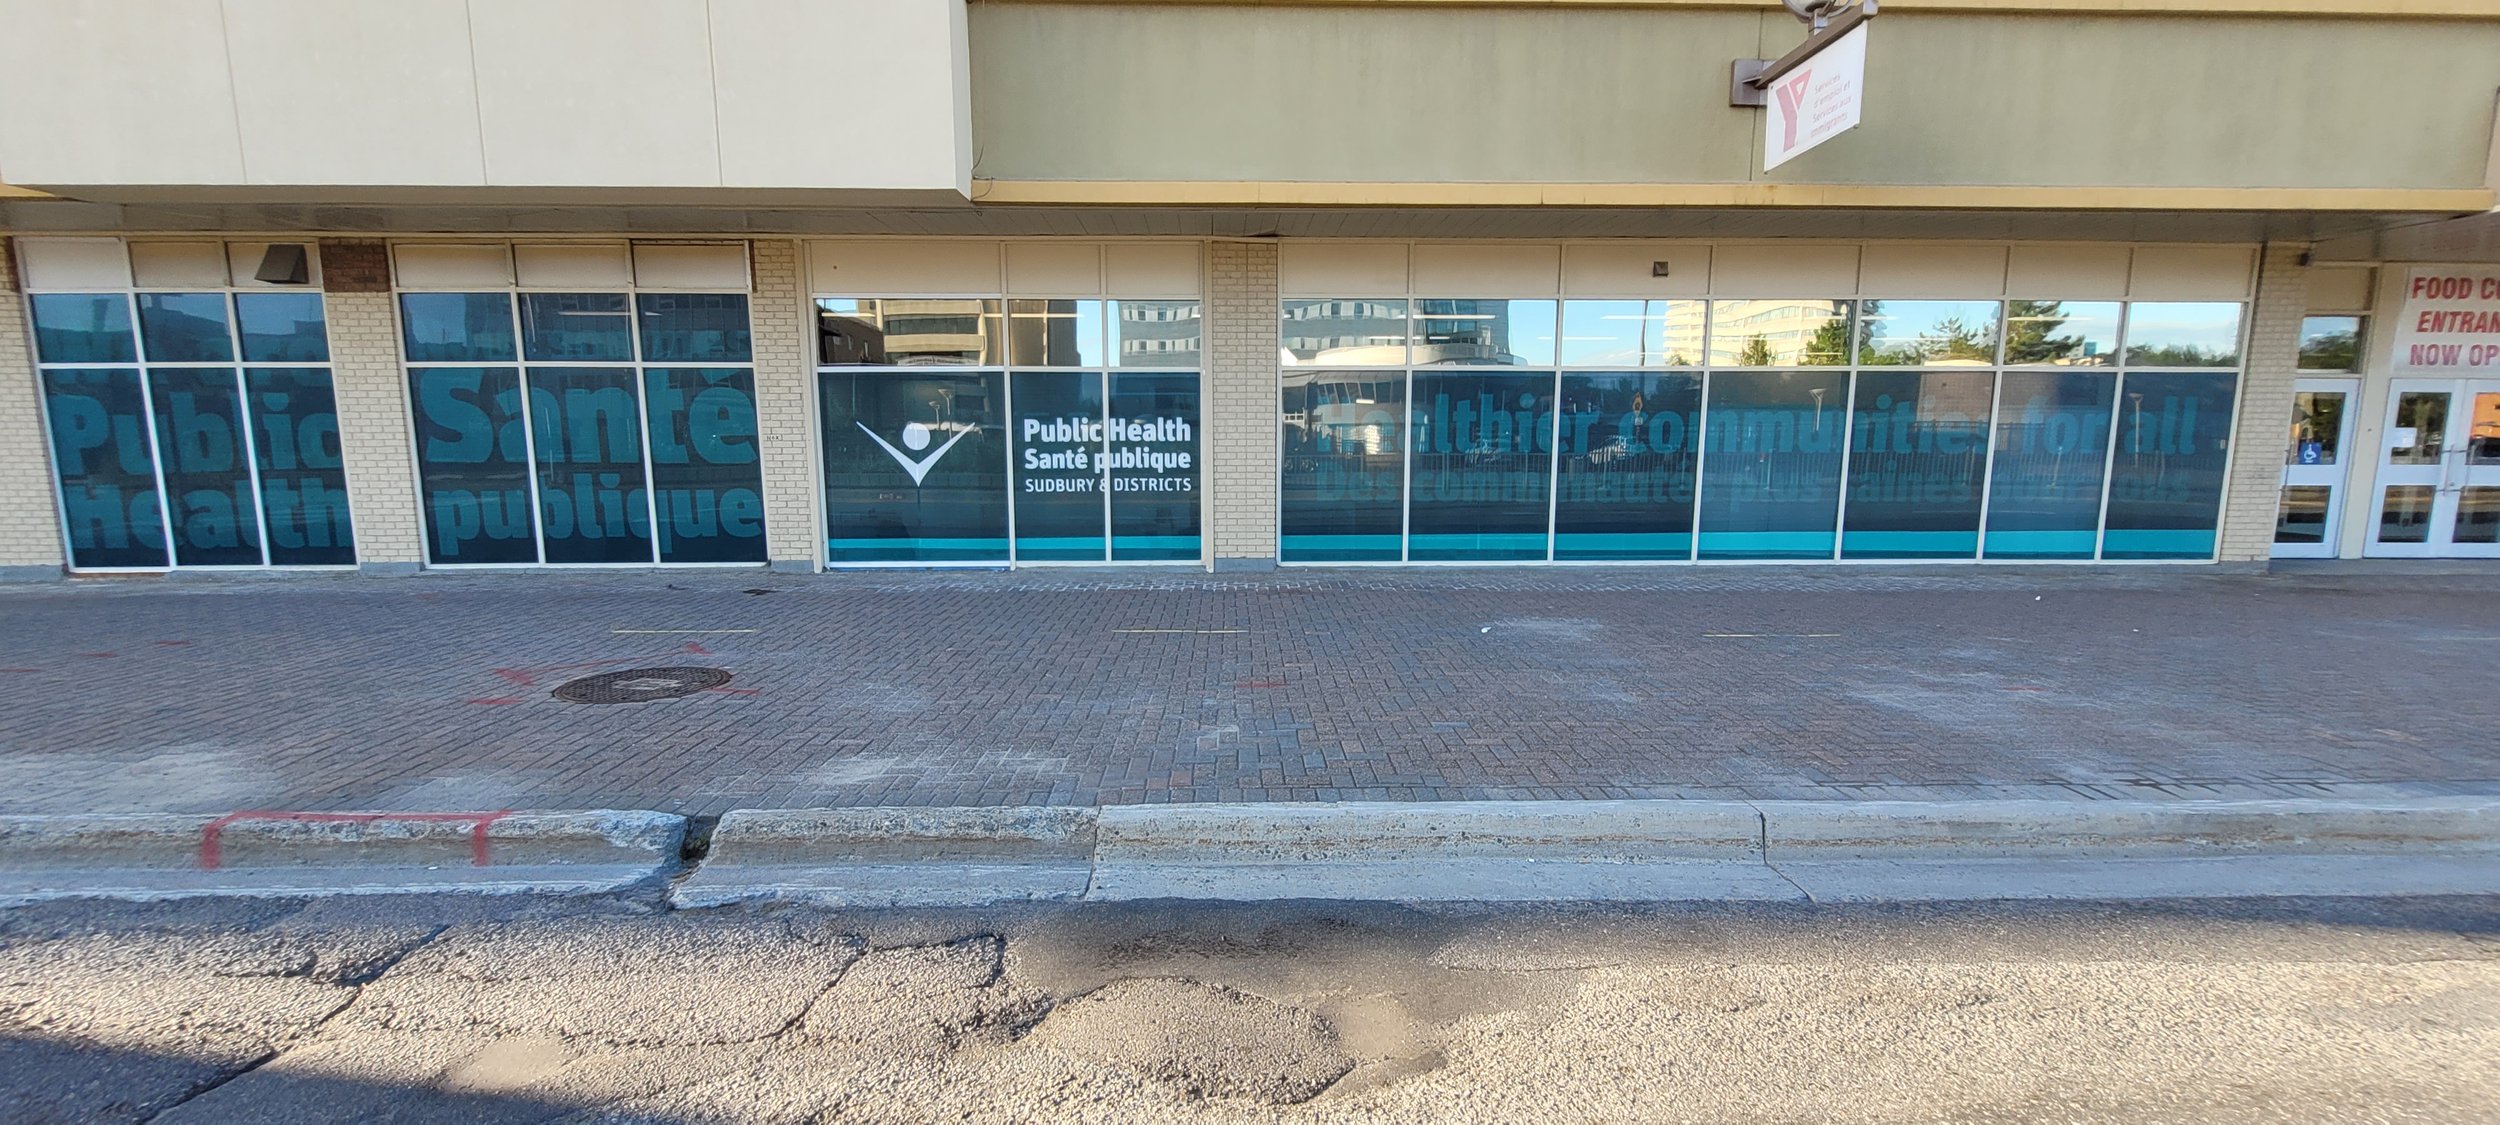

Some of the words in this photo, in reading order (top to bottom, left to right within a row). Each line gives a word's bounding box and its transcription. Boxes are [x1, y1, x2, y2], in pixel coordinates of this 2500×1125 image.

[2411, 277, 2473, 299] FOOD
[2409, 344, 2463, 366] NOW
[2469, 344, 2500, 366] OP
[51, 392, 343, 475] Public
[419, 367, 758, 464] Santé
[1023, 417, 1103, 442] Public
[1109, 417, 1191, 442] Health
[2020, 395, 2109, 455] for
[2122, 395, 2199, 456] all
[1024, 446, 1088, 470] Santé
[1094, 447, 1192, 474] publique
[1025, 478, 1095, 492] SUDBURY
[1114, 477, 1192, 492] DISTRICTS
[62, 477, 354, 549] Health
[431, 472, 763, 556] publique
